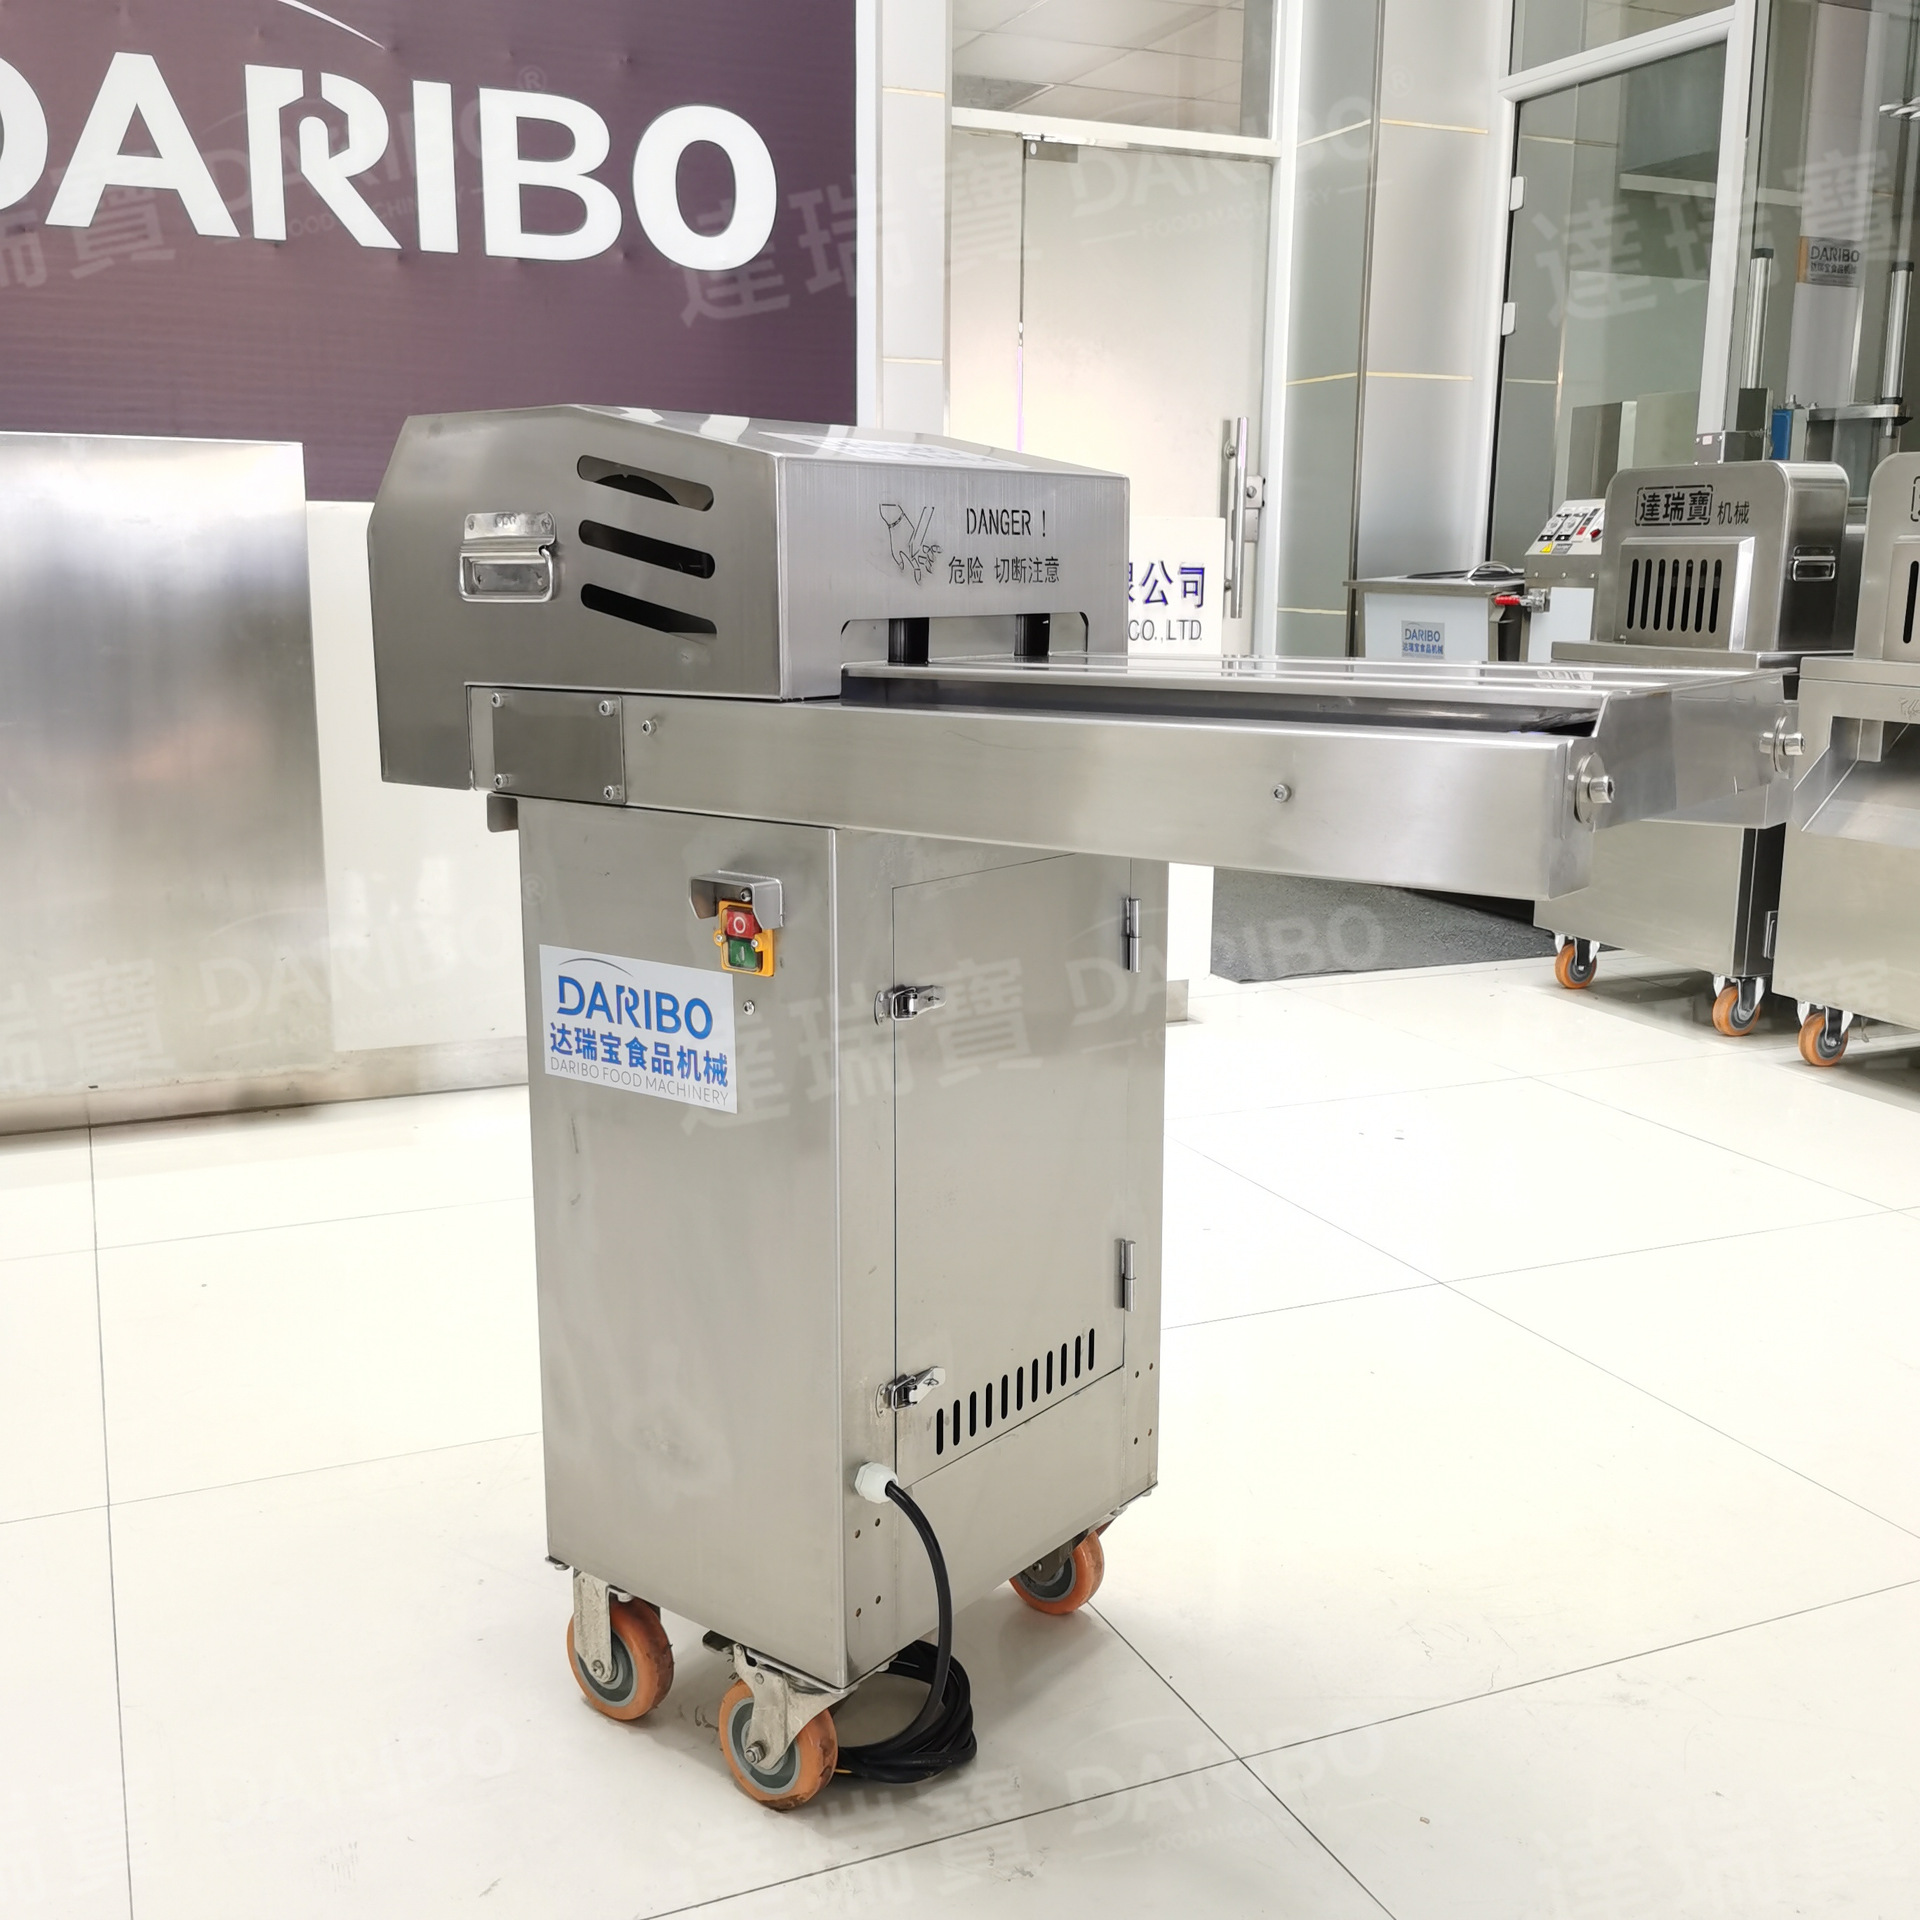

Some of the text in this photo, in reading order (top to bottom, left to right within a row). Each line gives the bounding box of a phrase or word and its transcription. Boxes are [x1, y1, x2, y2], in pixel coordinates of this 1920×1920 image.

[1809, 245, 1860, 263] DARIBO
[966, 507, 1032, 536] DANGER
[1640, 490, 1750, 526] 達瑞寶 机械
[948, 555, 1060, 585] 危险 切断注意
[1404, 628, 1441, 642] DARIBO
[556, 974, 714, 1040] DARIBO
[550, 1021, 729, 1088] 达瑞宝食品机械
[550, 1056, 729, 1107] DARIBO FOOD MACHINERY
